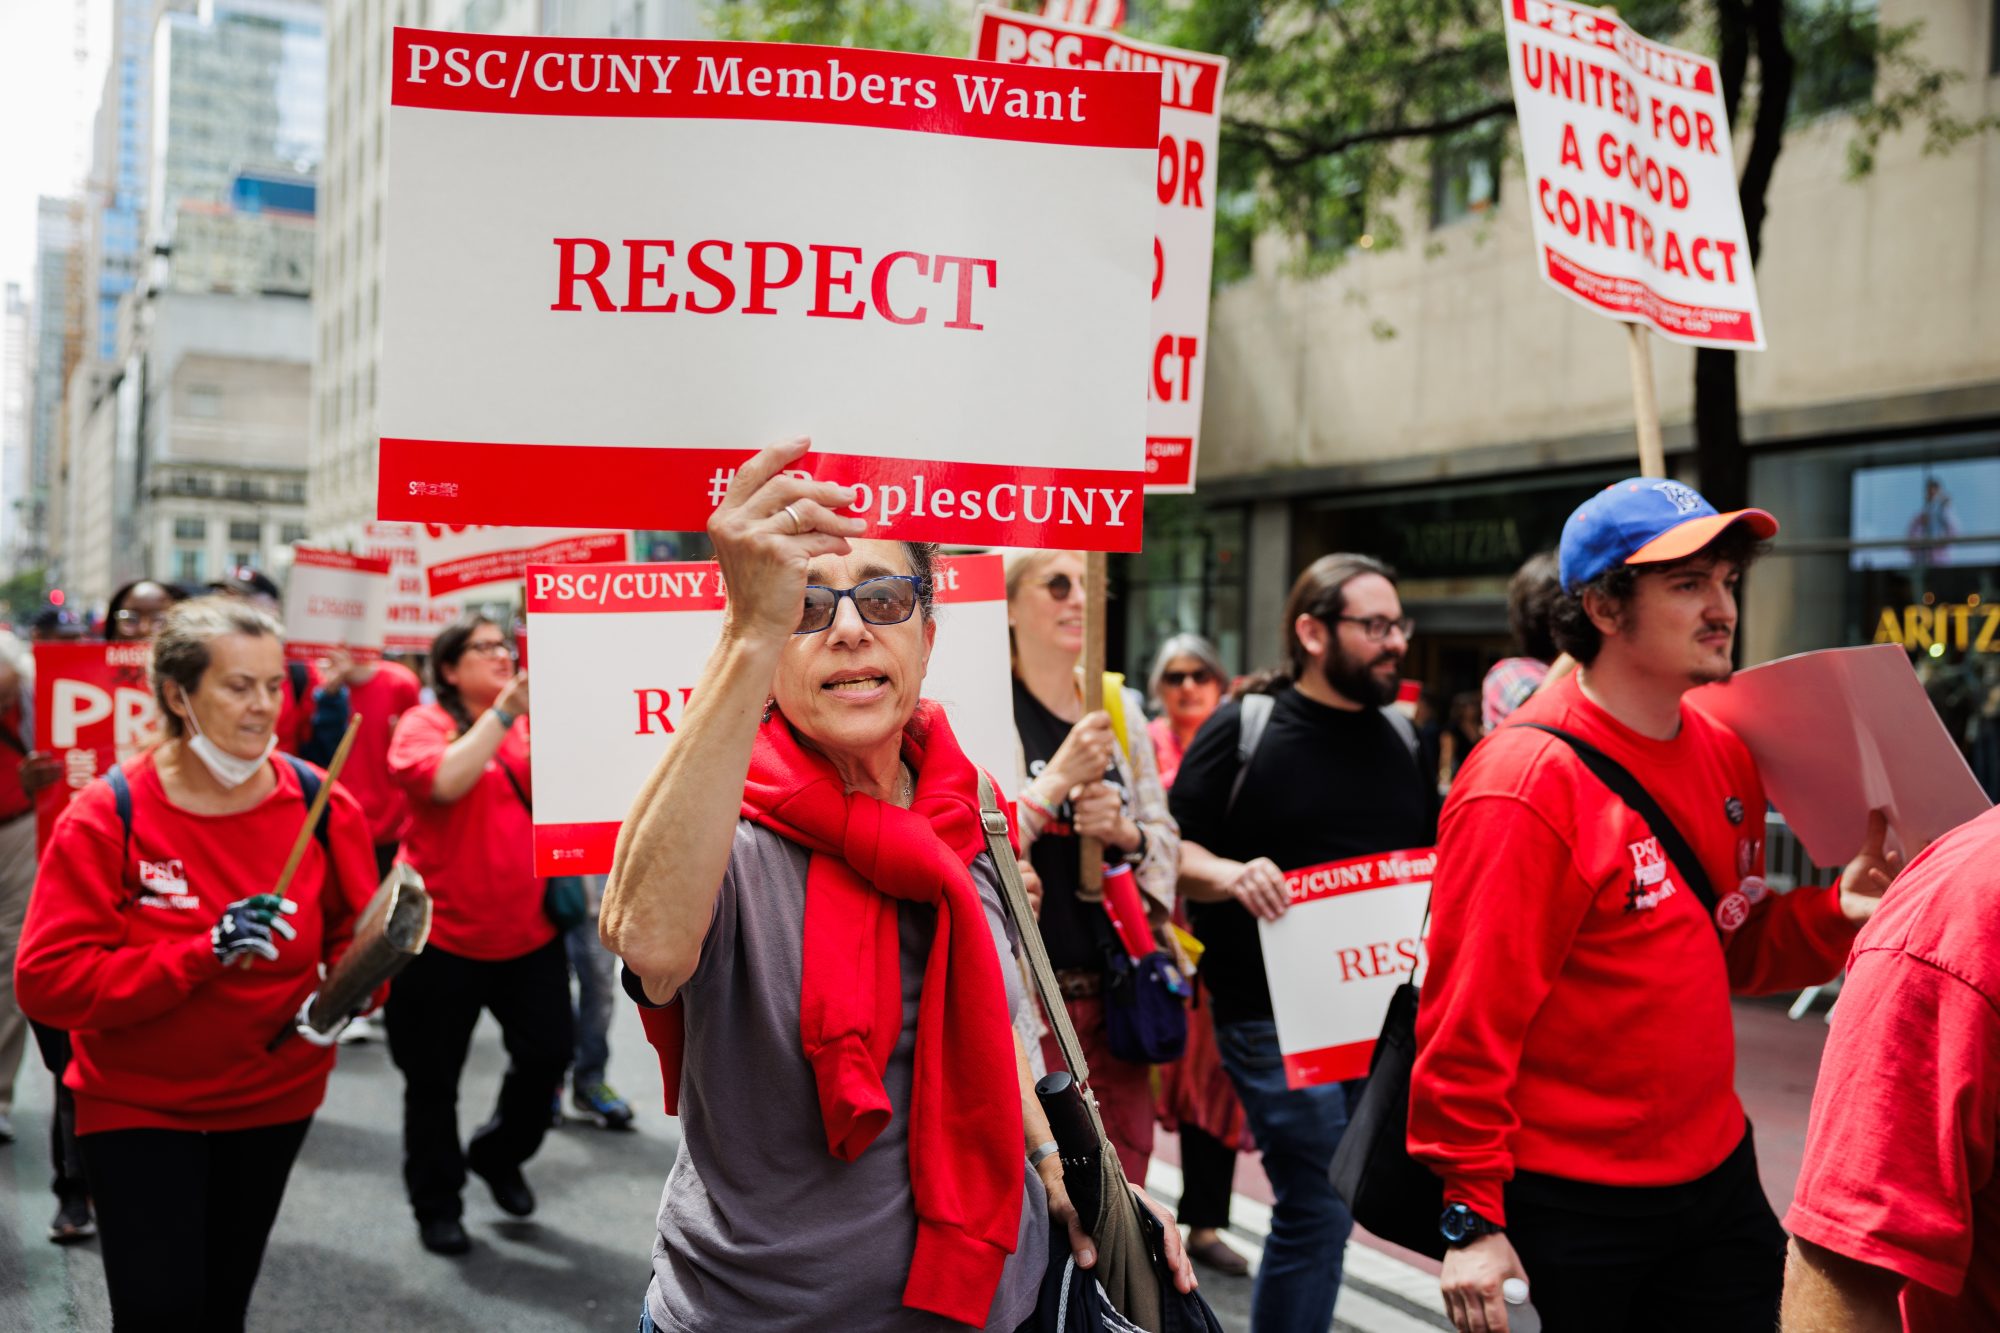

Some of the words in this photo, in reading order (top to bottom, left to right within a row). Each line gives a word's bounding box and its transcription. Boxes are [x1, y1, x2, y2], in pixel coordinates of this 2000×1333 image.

[405, 43, 681, 99] PSC/CUNY
[692, 55, 937, 109] Members
[953, 73, 1087, 123] Want
[1521, 42, 1641, 125] UNITED
[1650, 97, 1719, 156] FOR
[1560, 123, 1584, 172] A
[1597, 131, 1690, 210] GOOD
[1539, 177, 1738, 284] CONTRACT
[550, 237, 998, 331] RESPECT
[534, 572, 707, 605] PSC/CUNY
